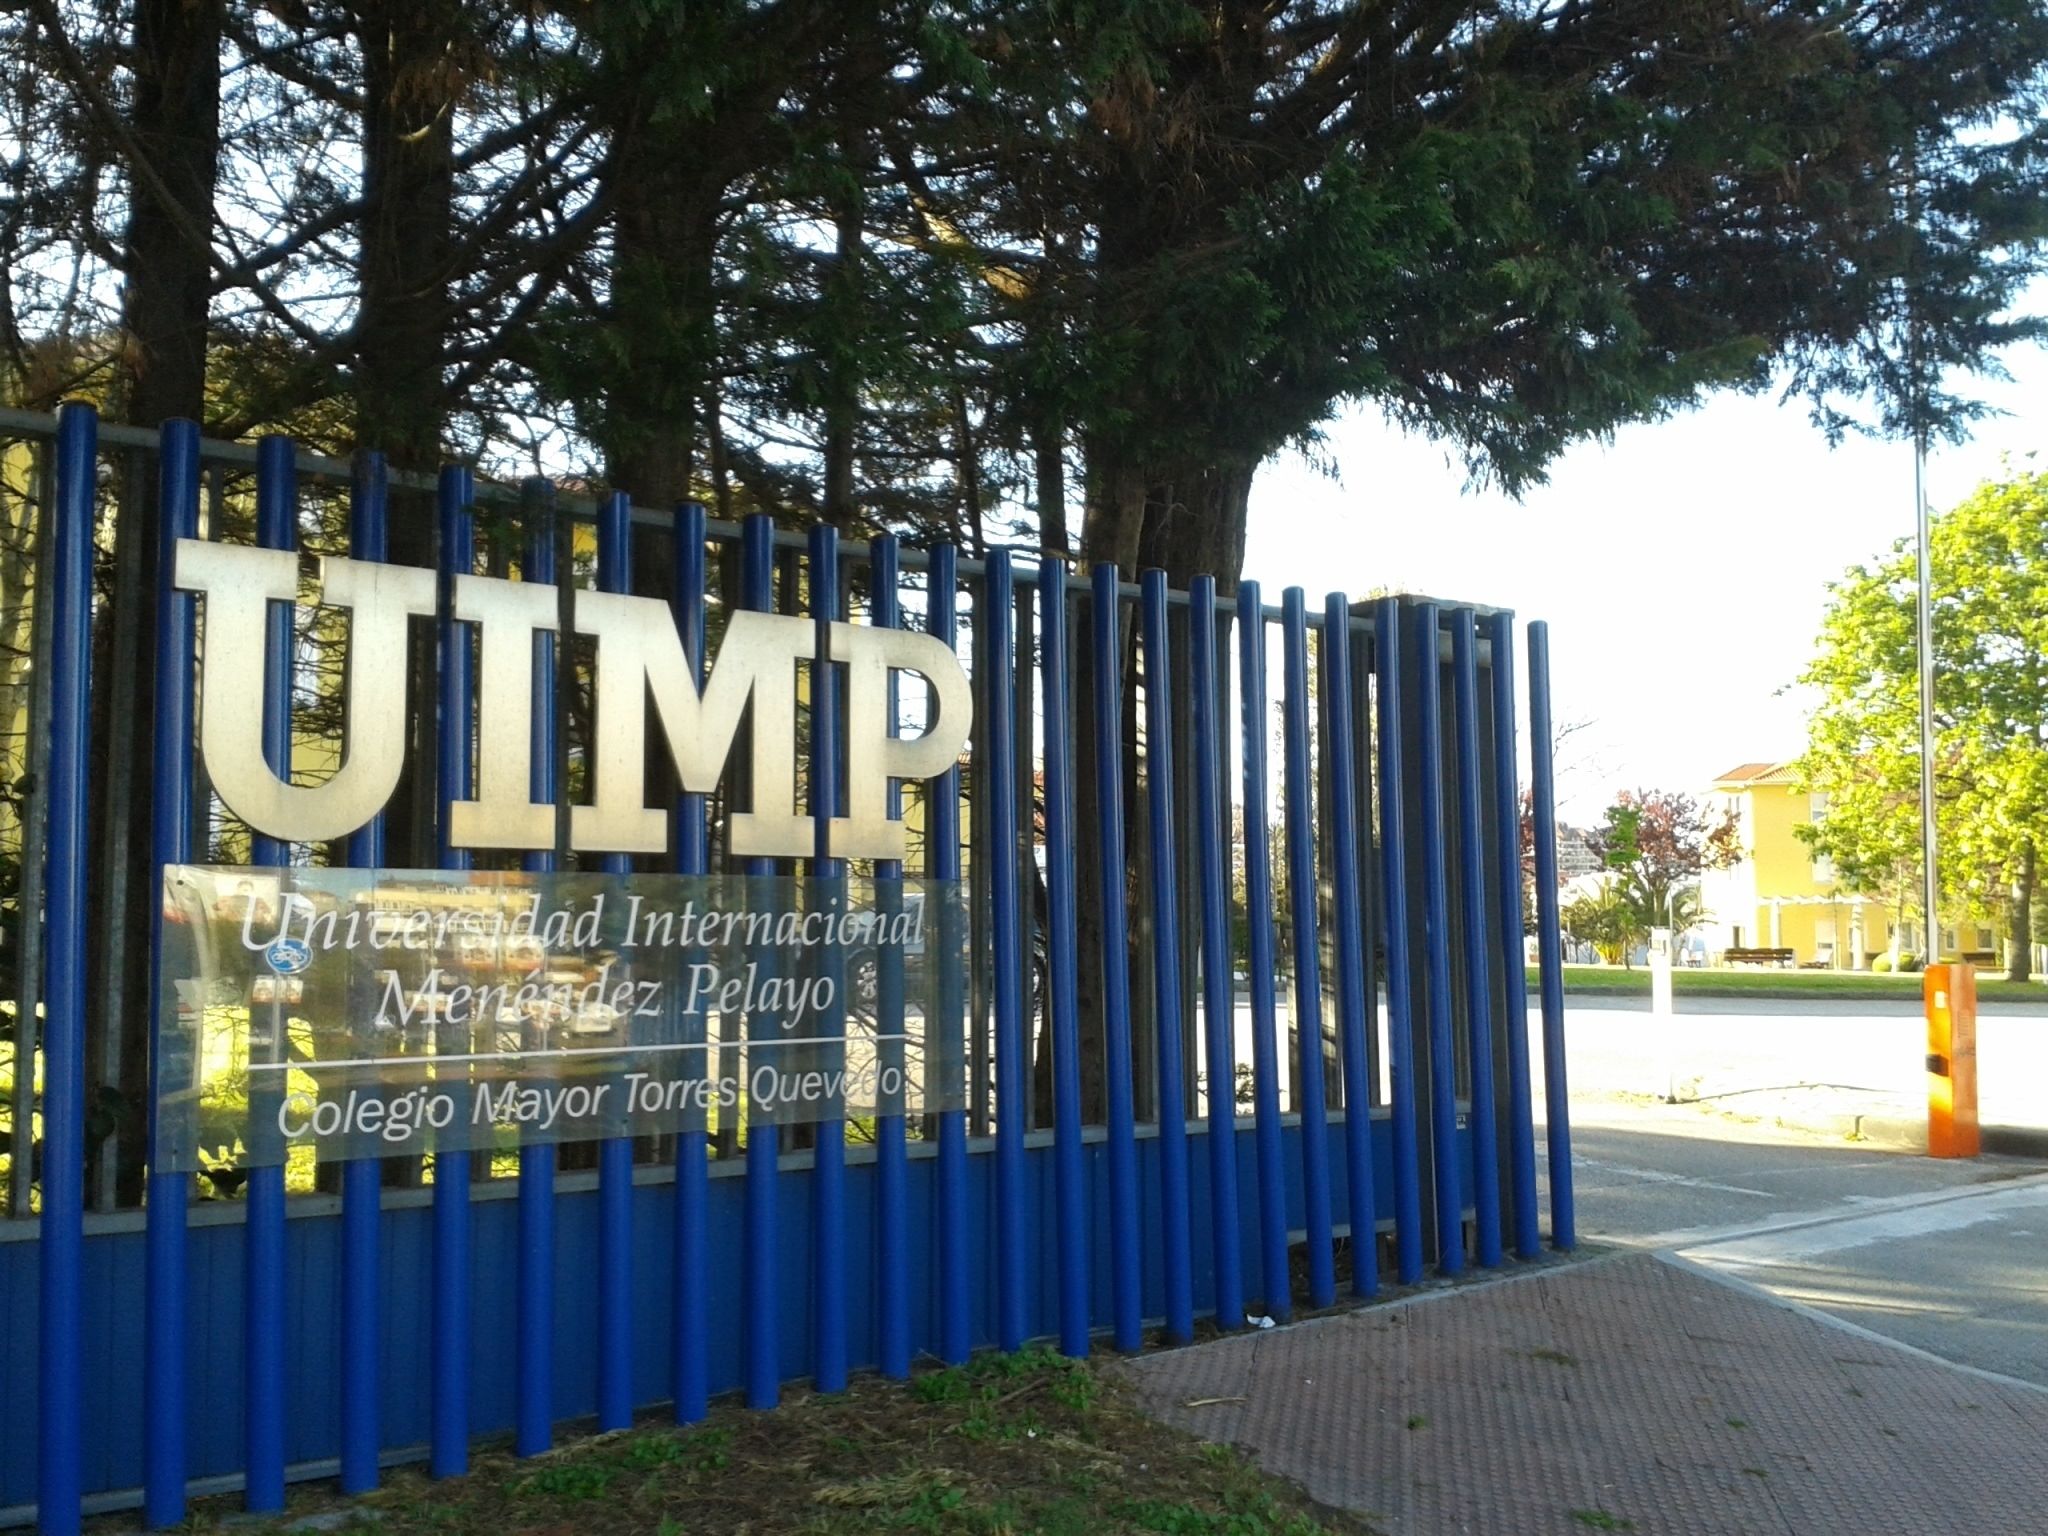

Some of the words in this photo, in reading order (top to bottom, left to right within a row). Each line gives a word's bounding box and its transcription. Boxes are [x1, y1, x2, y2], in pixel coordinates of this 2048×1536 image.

[173, 538, 974, 860] UIMP
[242, 892, 605, 951] Universidad
[621, 895, 925, 948] Internacional
[373, 964, 664, 1030] Menéndez
[682, 962, 836, 1030] Pelayo
[278, 1086, 455, 1142] Colegio
[472, 1080, 611, 1131] Mayor
[623, 1072, 738, 1114] Torres
[751, 1059, 902, 1111] Quevedo
